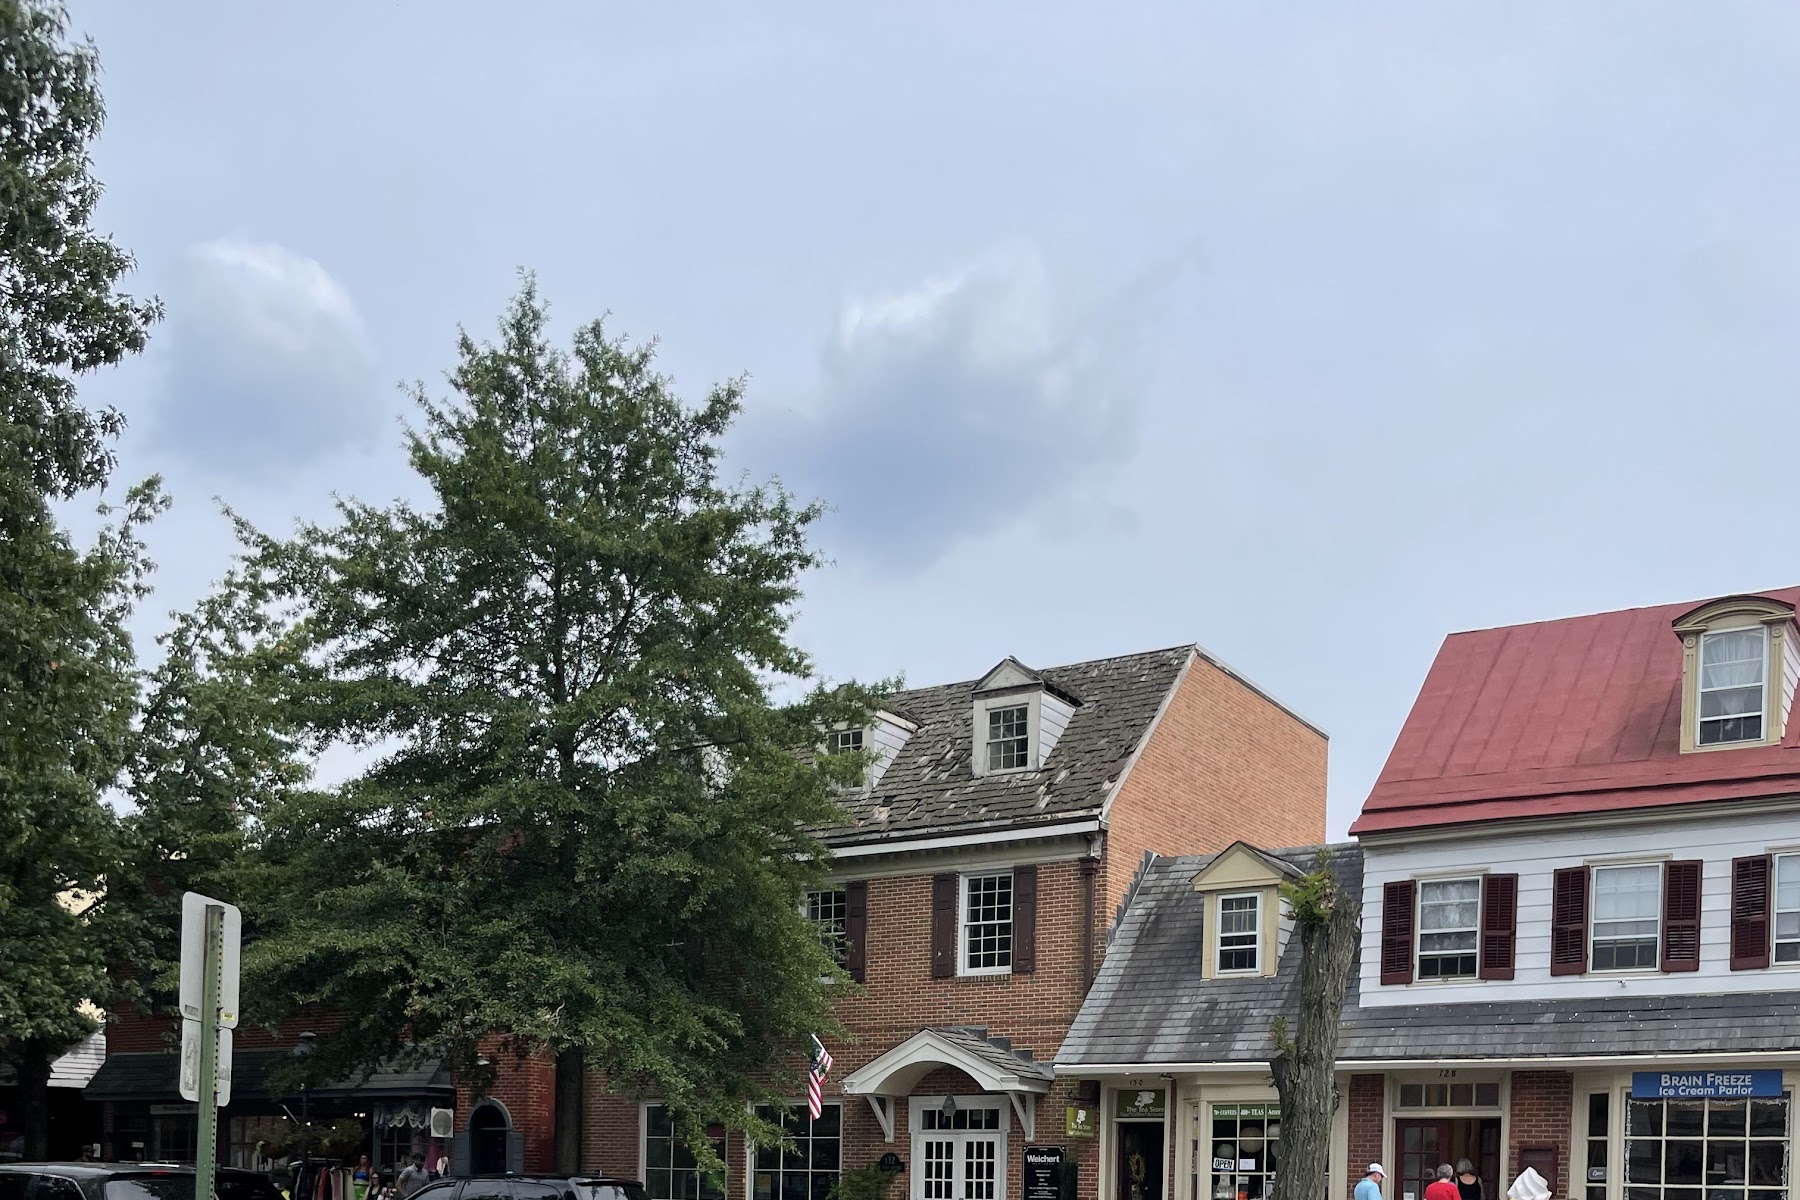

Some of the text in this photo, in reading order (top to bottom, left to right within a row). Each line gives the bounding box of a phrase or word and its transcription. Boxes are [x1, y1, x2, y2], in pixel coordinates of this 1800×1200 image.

[1439, 1069, 1457, 1078] 128
[1660, 1073, 1752, 1087] BRAIN FREEZE
[1659, 1085, 1754, 1096] Ice Cream Parlor
[1026, 1154, 1060, 1163] Weichert
[1215, 1159, 1233, 1169] OPEN
